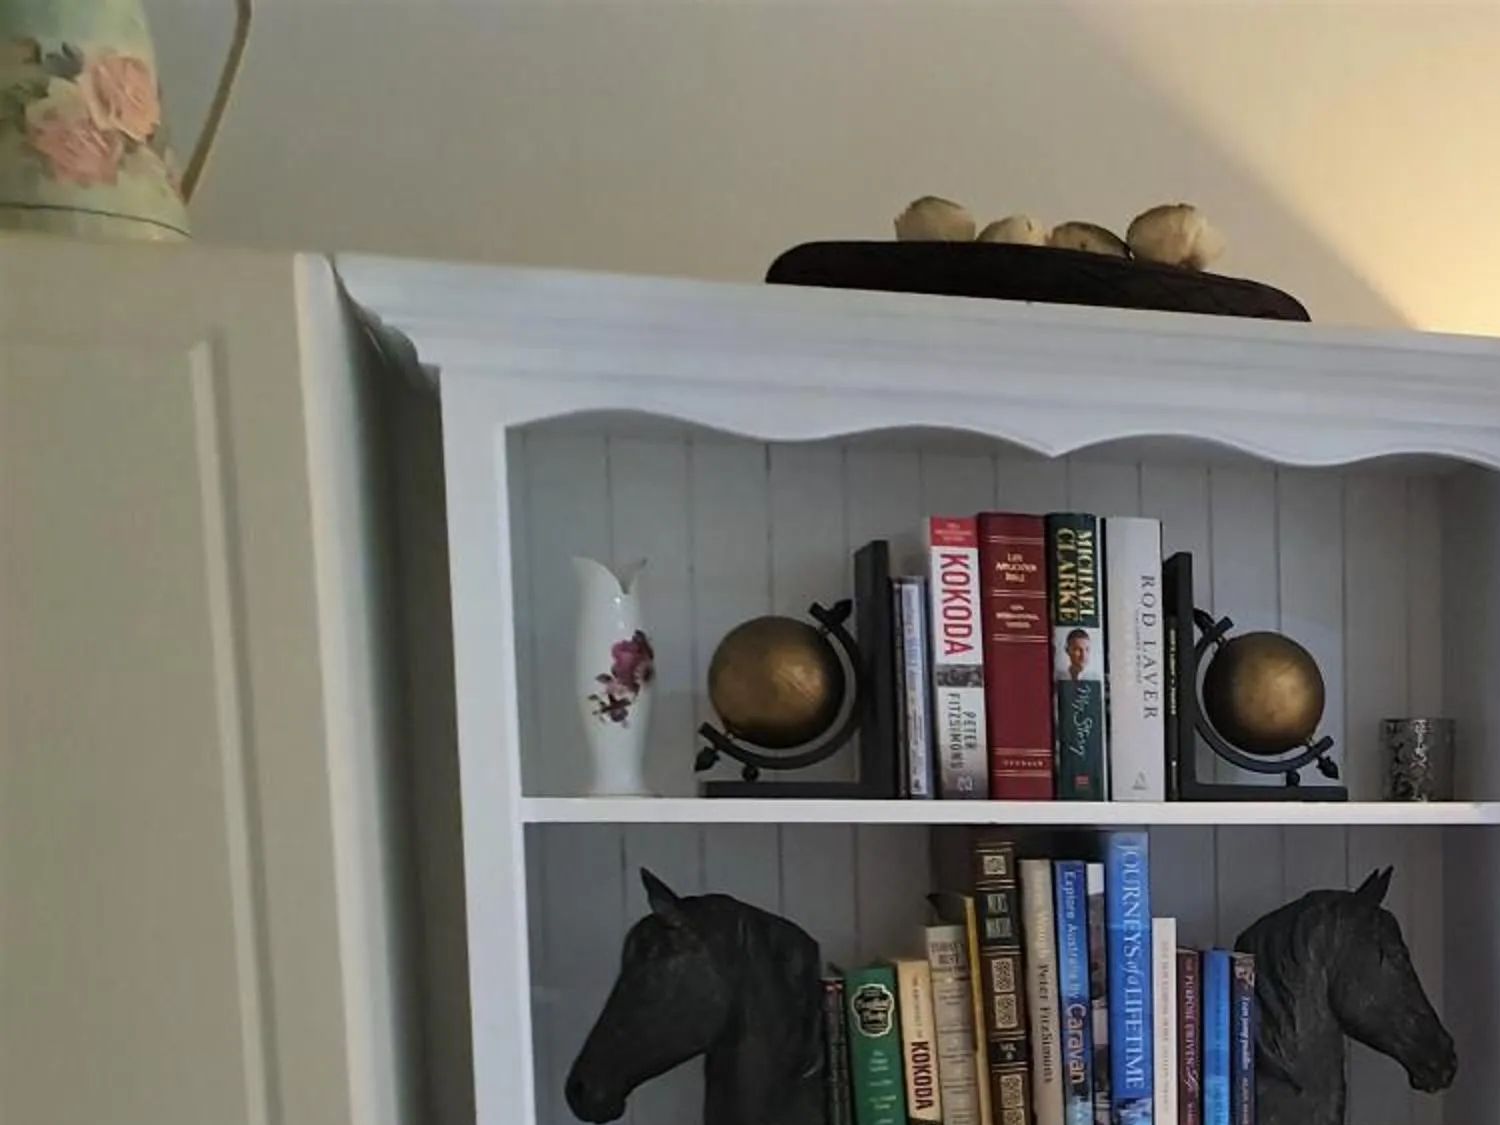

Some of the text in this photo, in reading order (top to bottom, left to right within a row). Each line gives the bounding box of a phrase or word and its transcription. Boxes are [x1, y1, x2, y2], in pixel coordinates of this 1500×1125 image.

[940, 553, 975, 657] KOKODA
[1057, 527, 1078, 622] CLARKE
[1078, 528, 1094, 621] MICHAEL
[1140, 575, 1159, 720] ROD LAVER
[962, 711, 977, 750] PETER
[1063, 870, 1077, 921] Explore
[1117, 844, 1142, 958] JOURNEYS
[1039, 964, 1050, 1000] Peter
[1066, 923, 1079, 980] Australia
[911, 1042, 934, 1110] KOKODA
[1068, 1003, 1086, 1084] Caravan
[1124, 987, 1145, 1089] LIFETIME
